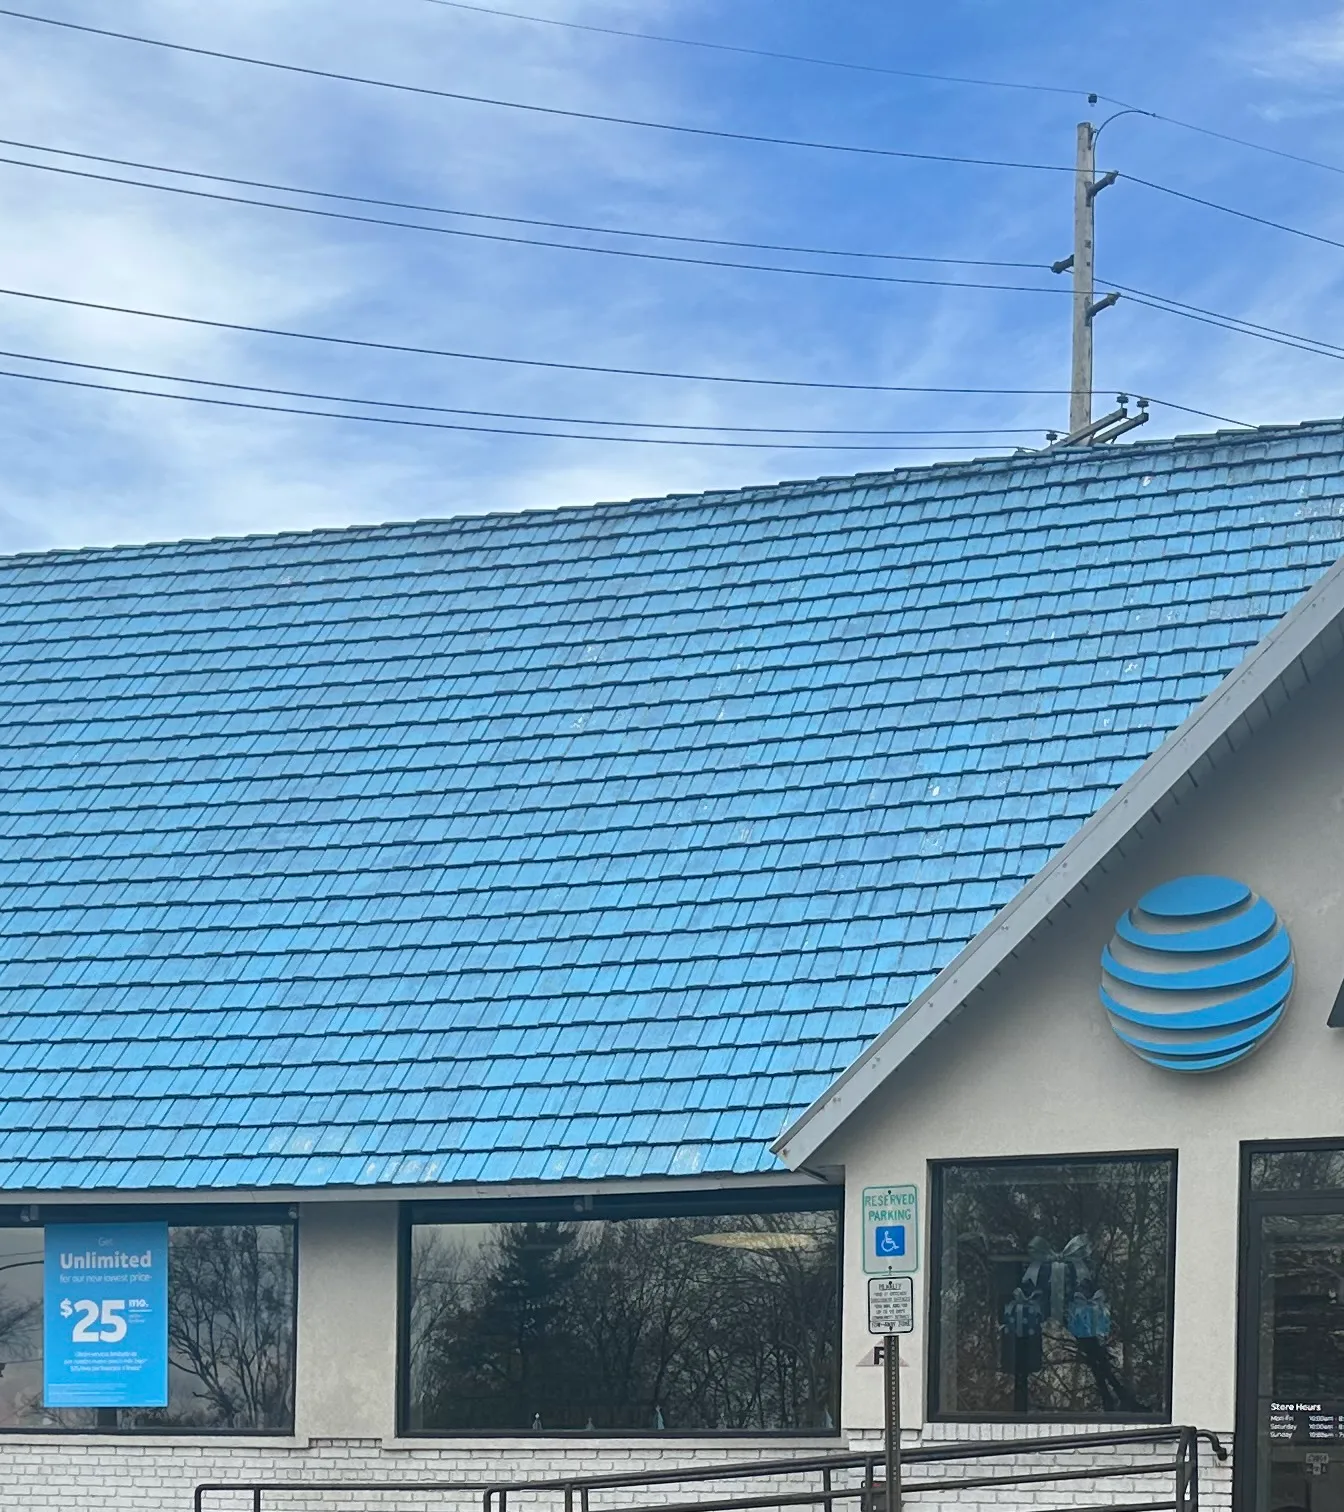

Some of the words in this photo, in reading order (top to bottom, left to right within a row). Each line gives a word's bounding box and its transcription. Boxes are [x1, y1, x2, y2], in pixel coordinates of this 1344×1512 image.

[864, 1193, 915, 1207] RESERVED
[868, 1209, 912, 1221] PARKING
[60, 1250, 152, 1269] Unlimited
[60, 1298, 128, 1343] $25
[1270, 1402, 1294, 1411] Store
[1296, 1403, 1322, 1411] Hours
[1270, 1431, 1293, 1439] Sunday
